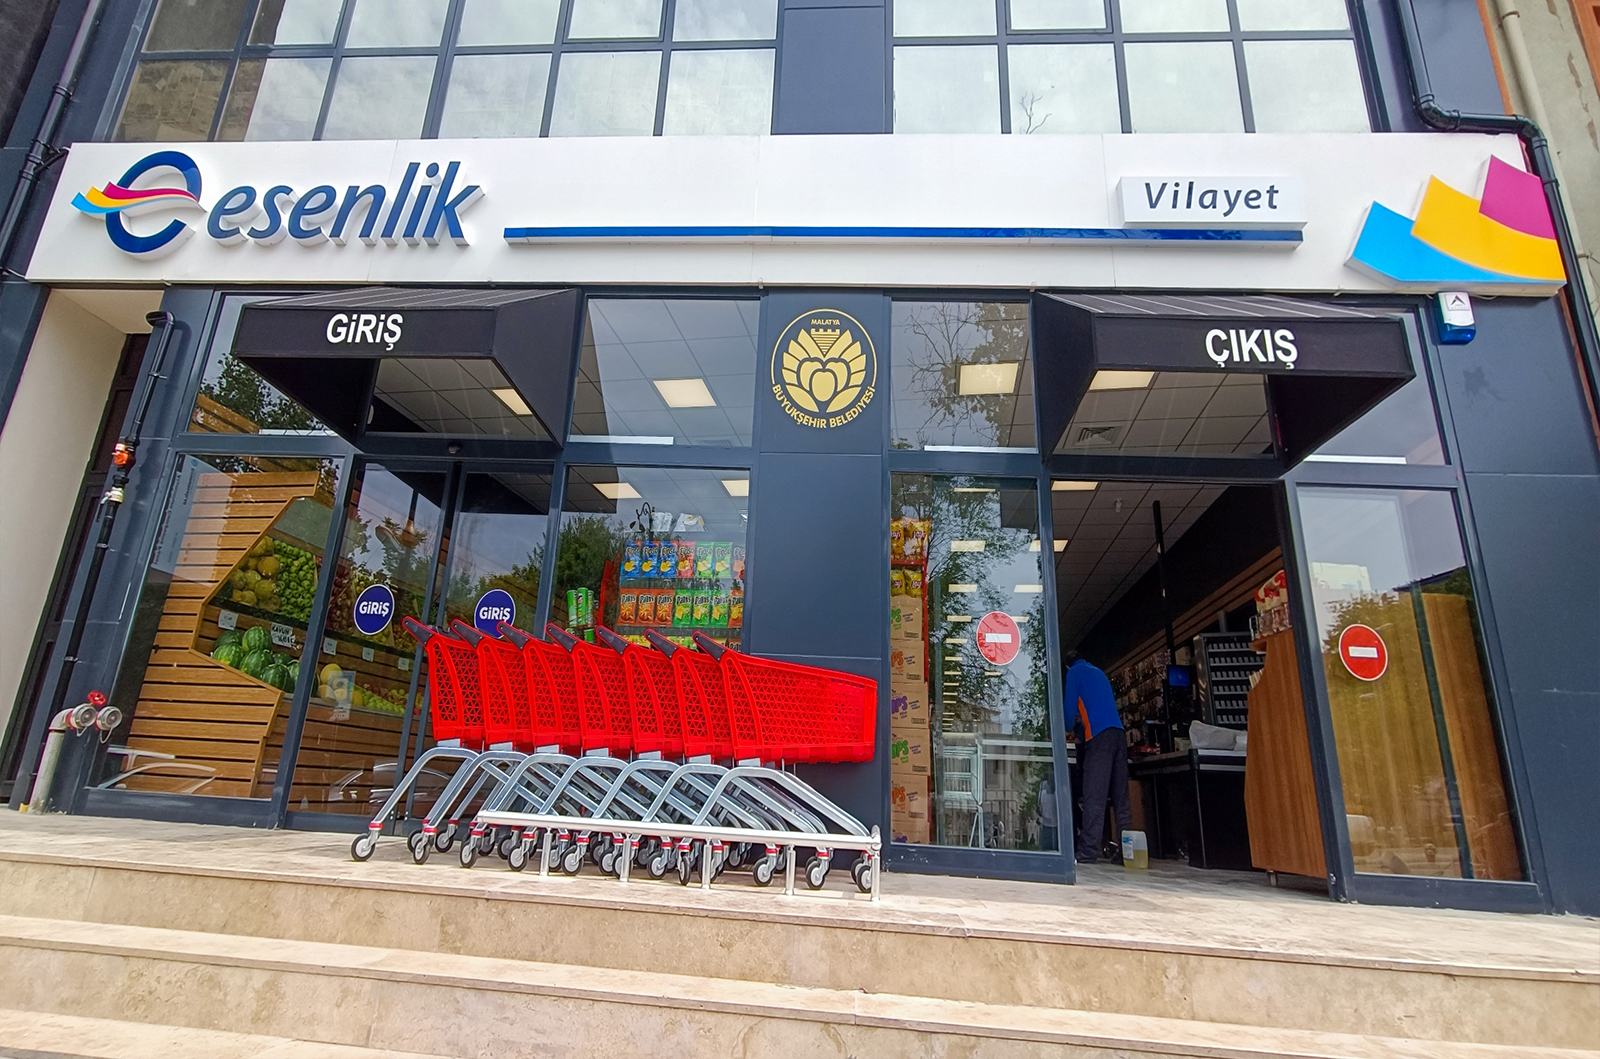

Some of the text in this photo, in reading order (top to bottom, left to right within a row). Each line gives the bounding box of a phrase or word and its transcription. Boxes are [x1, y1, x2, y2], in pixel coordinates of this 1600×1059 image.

[207, 160, 484, 244] esenlik
[1144, 181, 1279, 218] Vilayet
[811, 318, 840, 326] MALATYA
[1205, 329, 1299, 370] ÇIKIŞ
